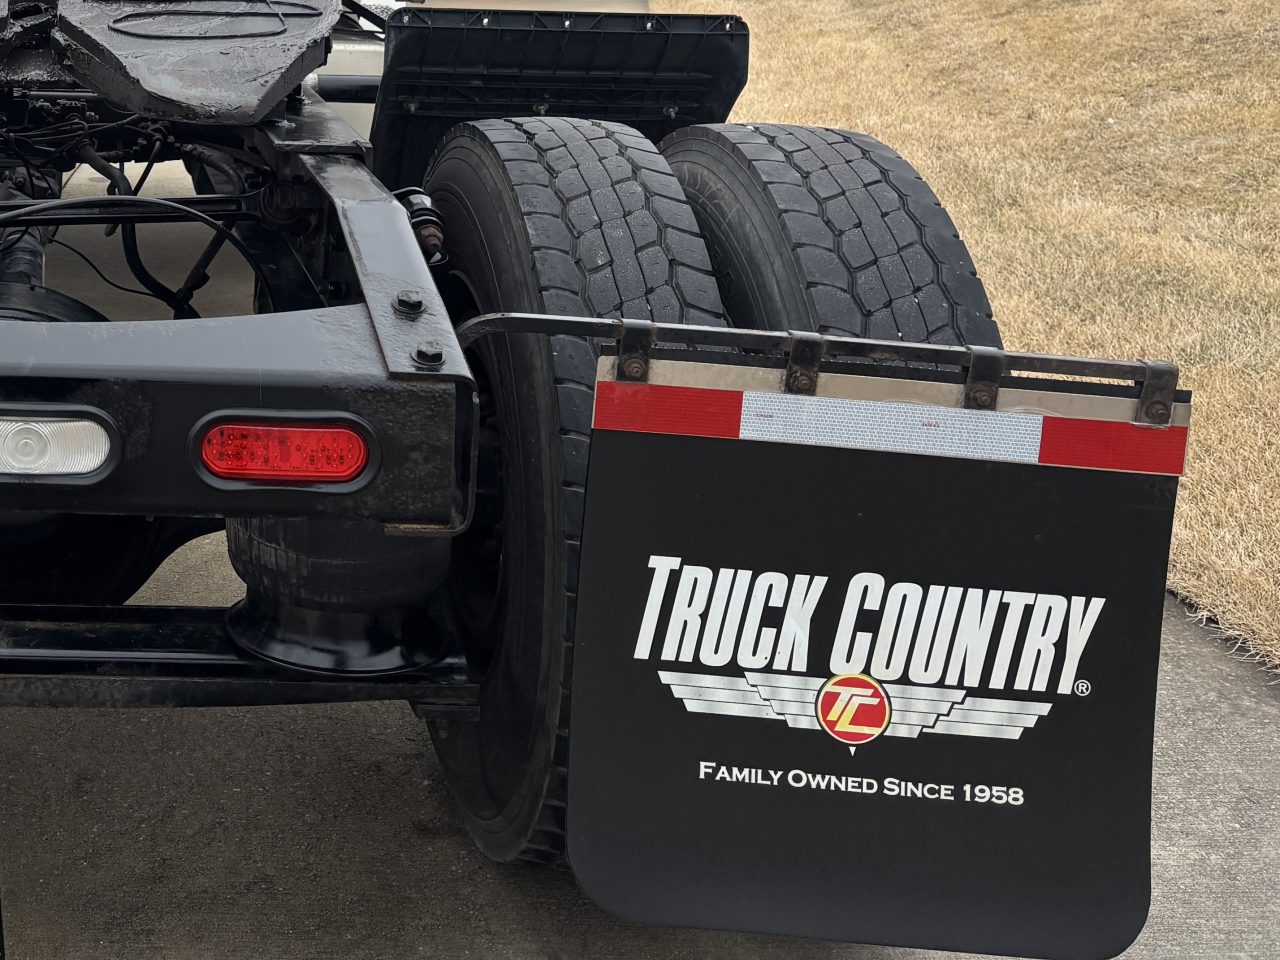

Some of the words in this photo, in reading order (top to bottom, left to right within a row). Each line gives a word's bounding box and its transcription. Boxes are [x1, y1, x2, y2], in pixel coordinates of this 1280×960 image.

[633, 555, 829, 672] TRUCK
[698, 761, 784, 787] FAMILY
[787, 769, 878, 795] OWNED
[882, 777, 955, 801] SINCE
[962, 784, 1025, 806] 1958
